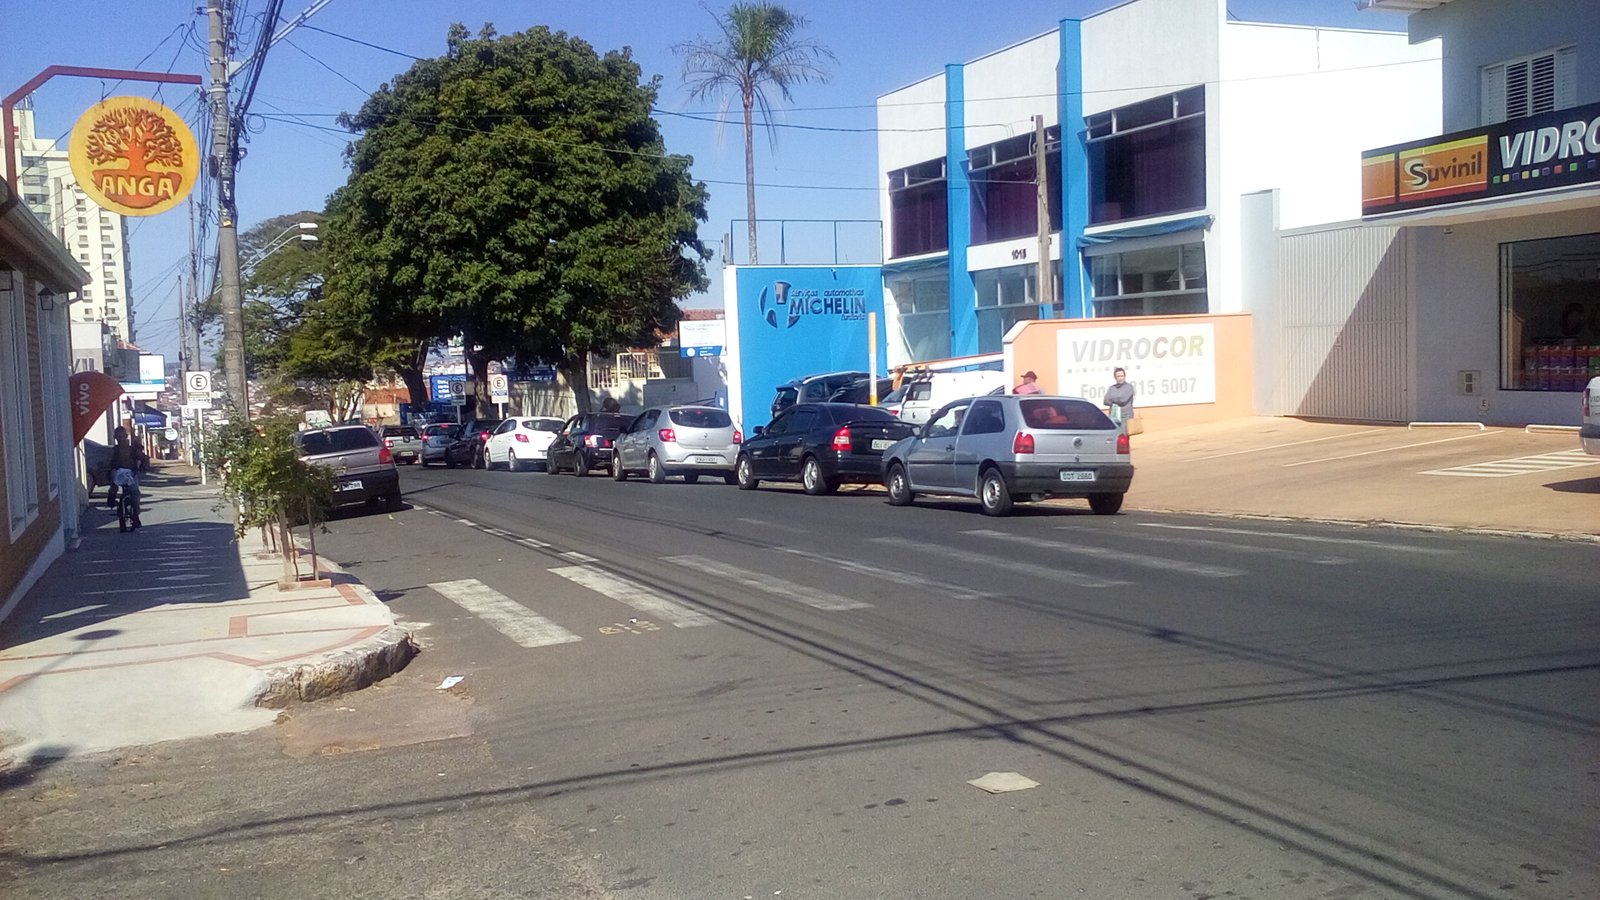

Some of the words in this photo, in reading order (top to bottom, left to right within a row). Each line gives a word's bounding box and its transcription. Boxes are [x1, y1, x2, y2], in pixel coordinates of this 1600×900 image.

[1404, 151, 1483, 190] Suvinil
[789, 297, 866, 315] MICHELIN
[1072, 335, 1205, 363] VIDROCOR
[75, 383, 90, 416] vivo
[1161, 377, 1197, 394] 5007
